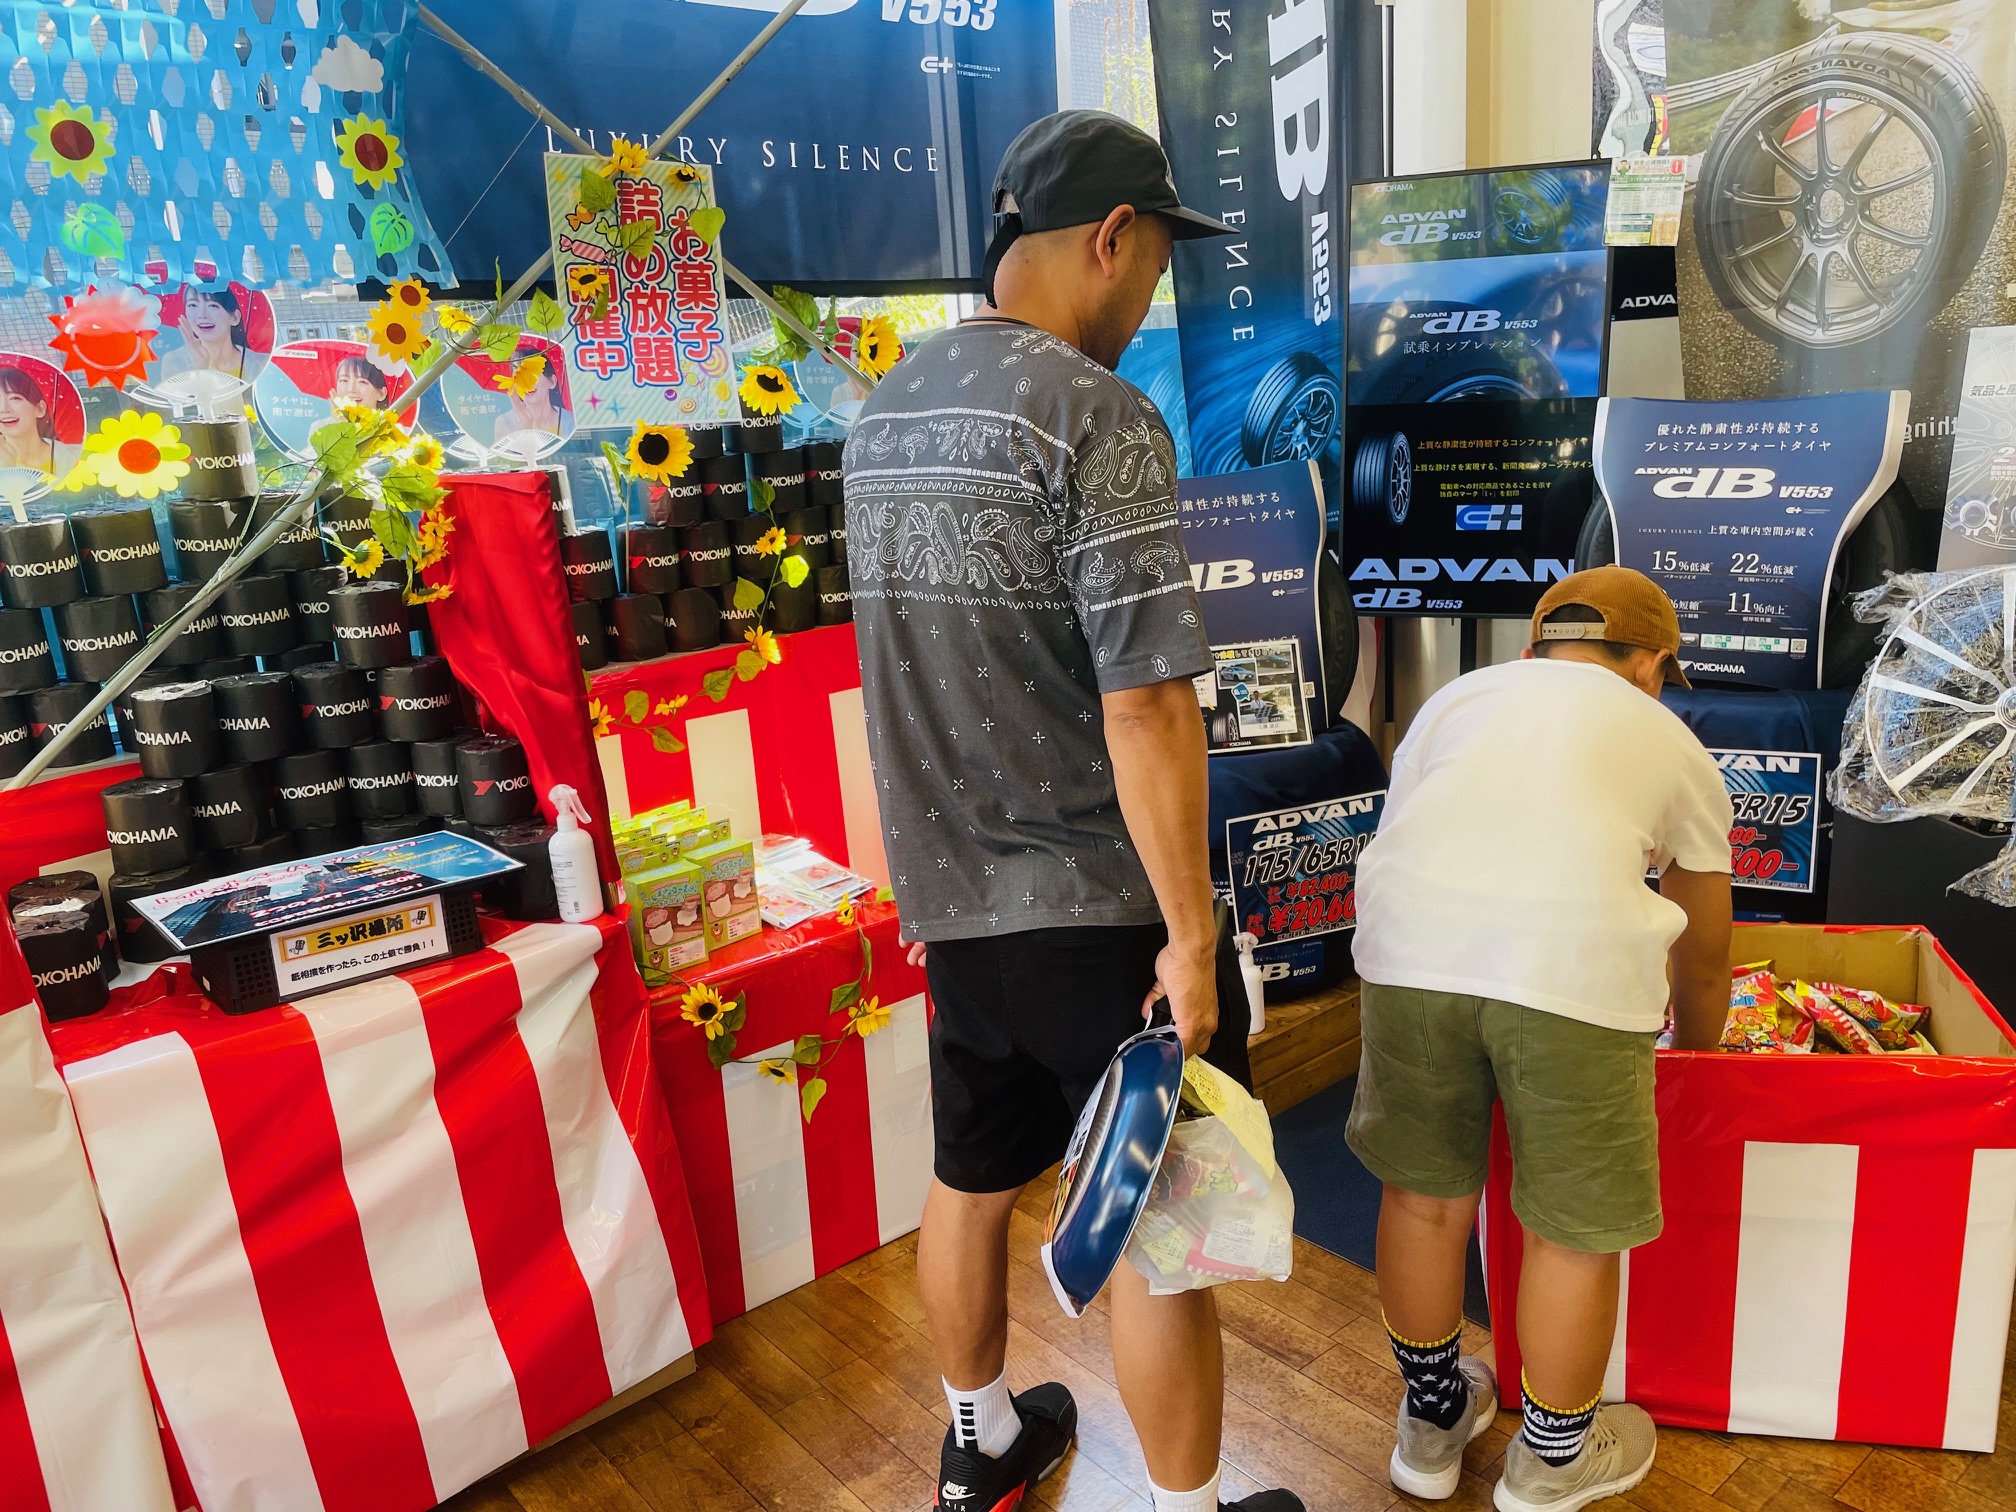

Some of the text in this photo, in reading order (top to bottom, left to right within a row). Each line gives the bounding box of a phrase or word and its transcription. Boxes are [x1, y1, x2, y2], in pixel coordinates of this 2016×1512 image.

[762, 139, 939, 173] SILENCE
[1372, 183, 1414, 193] YOKOHAMA
[1380, 208, 1467, 225] ADVAN
[1379, 222, 1482, 246] dB V553
[615, 177, 683, 387] 詰め放題
[668, 207, 722, 362] お菓子
[1619, 294, 1677, 309] ADVA
[1422, 309, 1501, 335] dB
[1504, 319, 1539, 330] V553
[271, 395, 316, 407] タイヤは、
[1657, 421, 1820, 436] 優れた静粛性が持続する
[1644, 440, 1832, 452] プレミアムコンフォートタイヤ
[1634, 467, 1834, 499] ADVAN dB V553
[1707, 525, 1815, 538] 上質な車内空間が続く
[1261, 568, 1305, 584] V553
[1348, 558, 1575, 583] ADVAN
[1352, 587, 1463, 609] dB V553
[220, 608, 291, 627] YOKOHAMA
[297, 602, 330, 615] YOKO
[335, 622, 402, 640] YOKOHAMA
[63, 630, 138, 651] YOKOHAMA
[1692, 662, 1746, 674] YOKOHAMA
[1252, 797, 1374, 835] ADVAN
[1252, 831, 1294, 852] dB
[1243, 832, 1378, 888] 175/65R1
[1293, 965, 1316, 977] V553
[945, 1480, 968, 1496] NIKE
[945, 1500, 966, 1512] AIR
